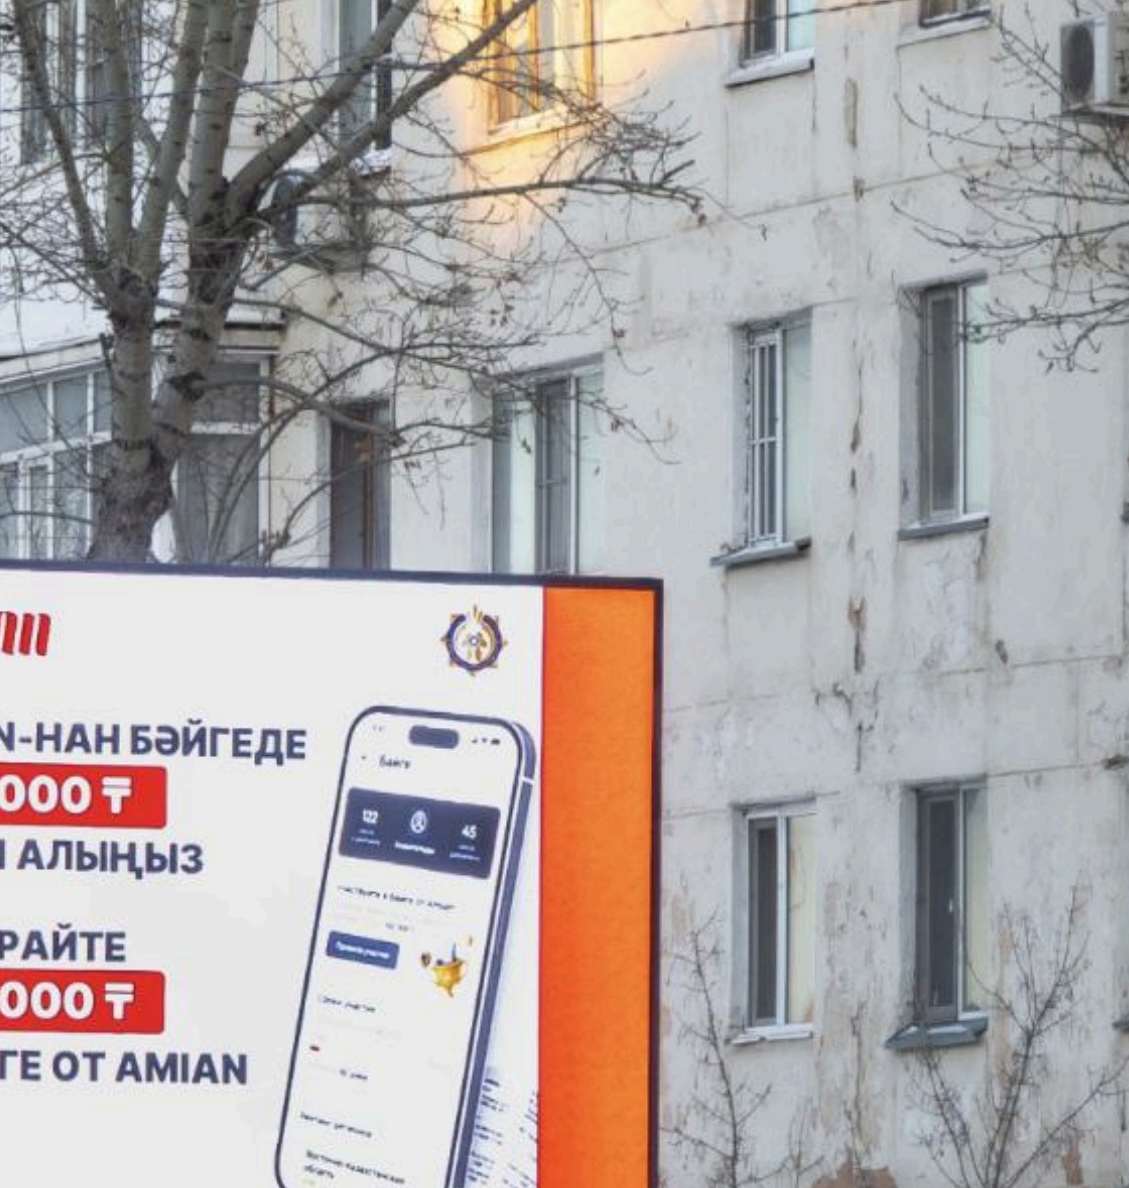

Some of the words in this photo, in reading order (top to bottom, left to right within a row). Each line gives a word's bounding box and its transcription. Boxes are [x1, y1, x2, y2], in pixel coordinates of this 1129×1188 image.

[130, 719, 307, 766] БӘЙГЕДЕ
[17, 839, 204, 880] АЛЫҢЫЗ
[52, 1051, 106, 1082] ОТ
[116, 1053, 248, 1085] AMIAN
